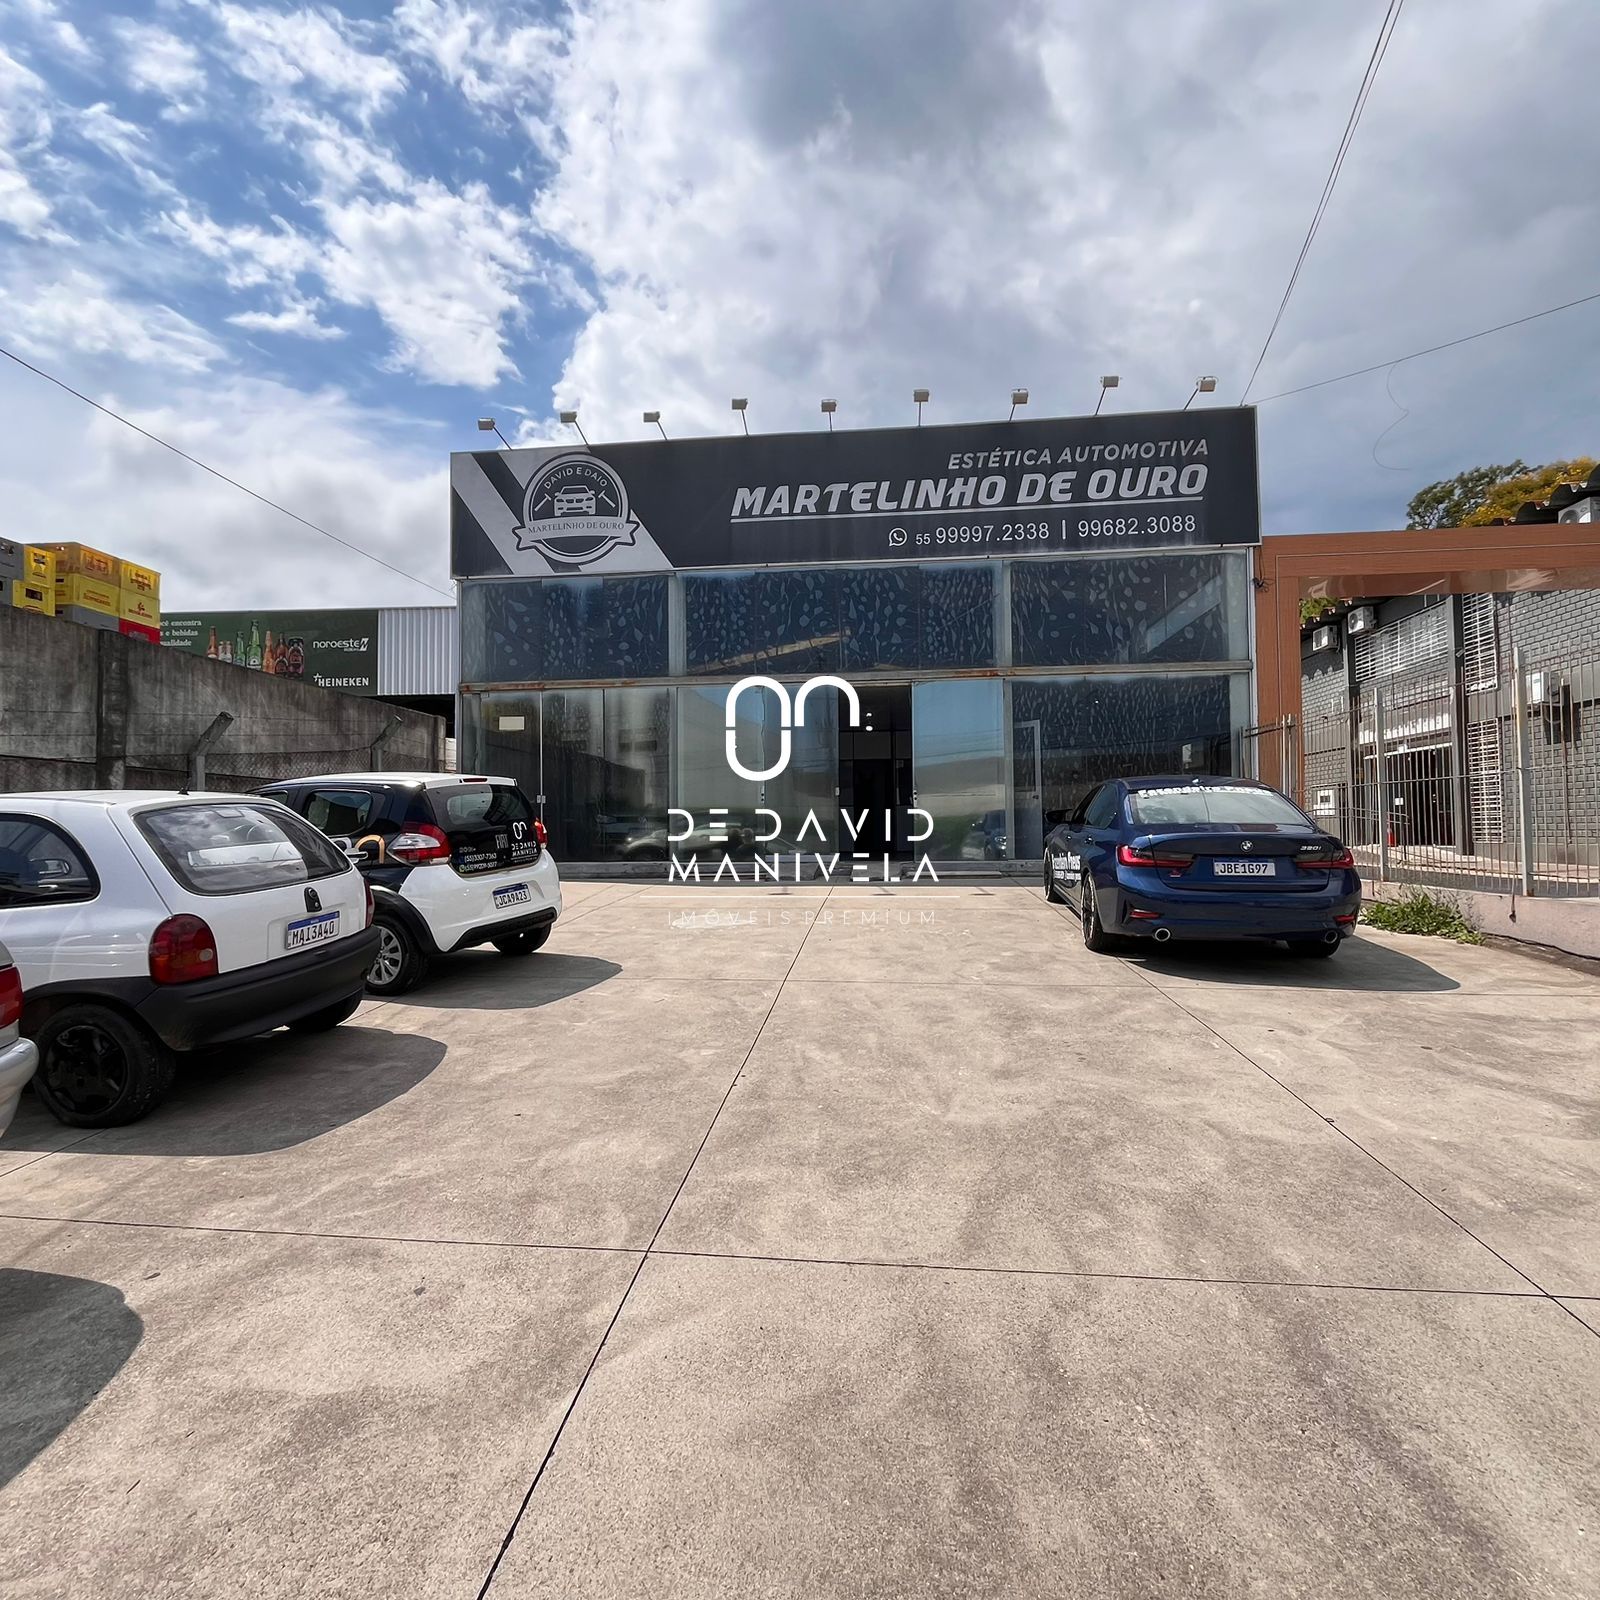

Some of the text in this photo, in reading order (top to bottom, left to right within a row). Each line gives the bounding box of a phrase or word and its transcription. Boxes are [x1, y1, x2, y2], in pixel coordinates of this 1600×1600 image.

[948, 438, 1208, 470] ESTÉTICA AUTOMOTIVA
[543, 467, 608, 489] DAVID E DAIO
[731, 463, 1209, 517] MARTELINHO DE OURO
[528, 521, 624, 534] MARTELINHO DE OURO
[915, 514, 1196, 545] 55 99997.2338 99682.3088
[312, 638, 360, 649] noroeste
[318, 677, 369, 687] HEINEKEN
[1220, 863, 1268, 874] JBE1G97
[292, 920, 335, 945] MAI3A40
